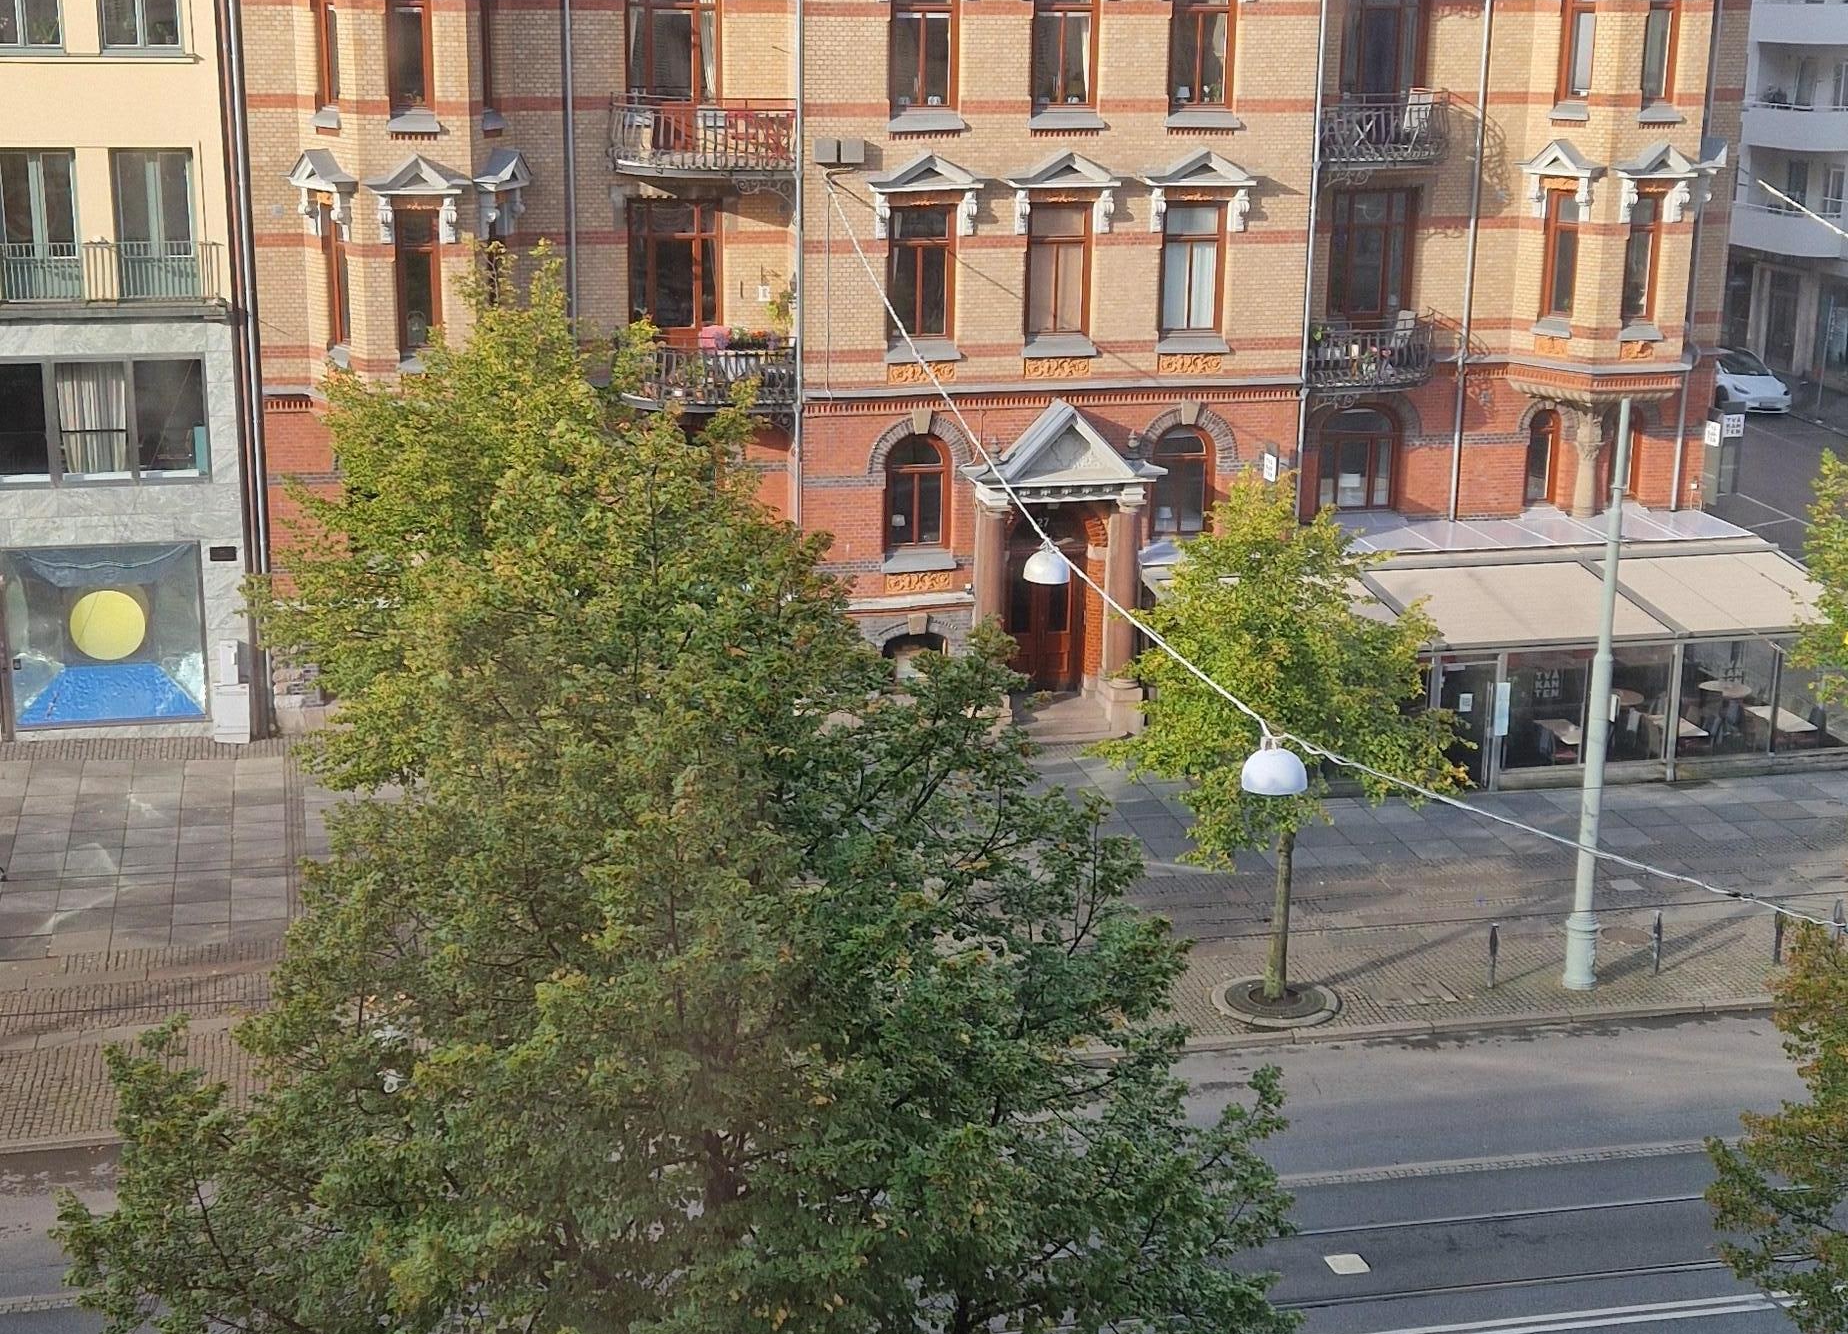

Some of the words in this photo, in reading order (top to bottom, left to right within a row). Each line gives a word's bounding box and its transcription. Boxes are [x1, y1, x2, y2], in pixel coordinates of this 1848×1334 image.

[1036, 517, 1050, 528] 27
[1535, 680, 1560, 688] KAN
[1534, 689, 1560, 698] TEN
